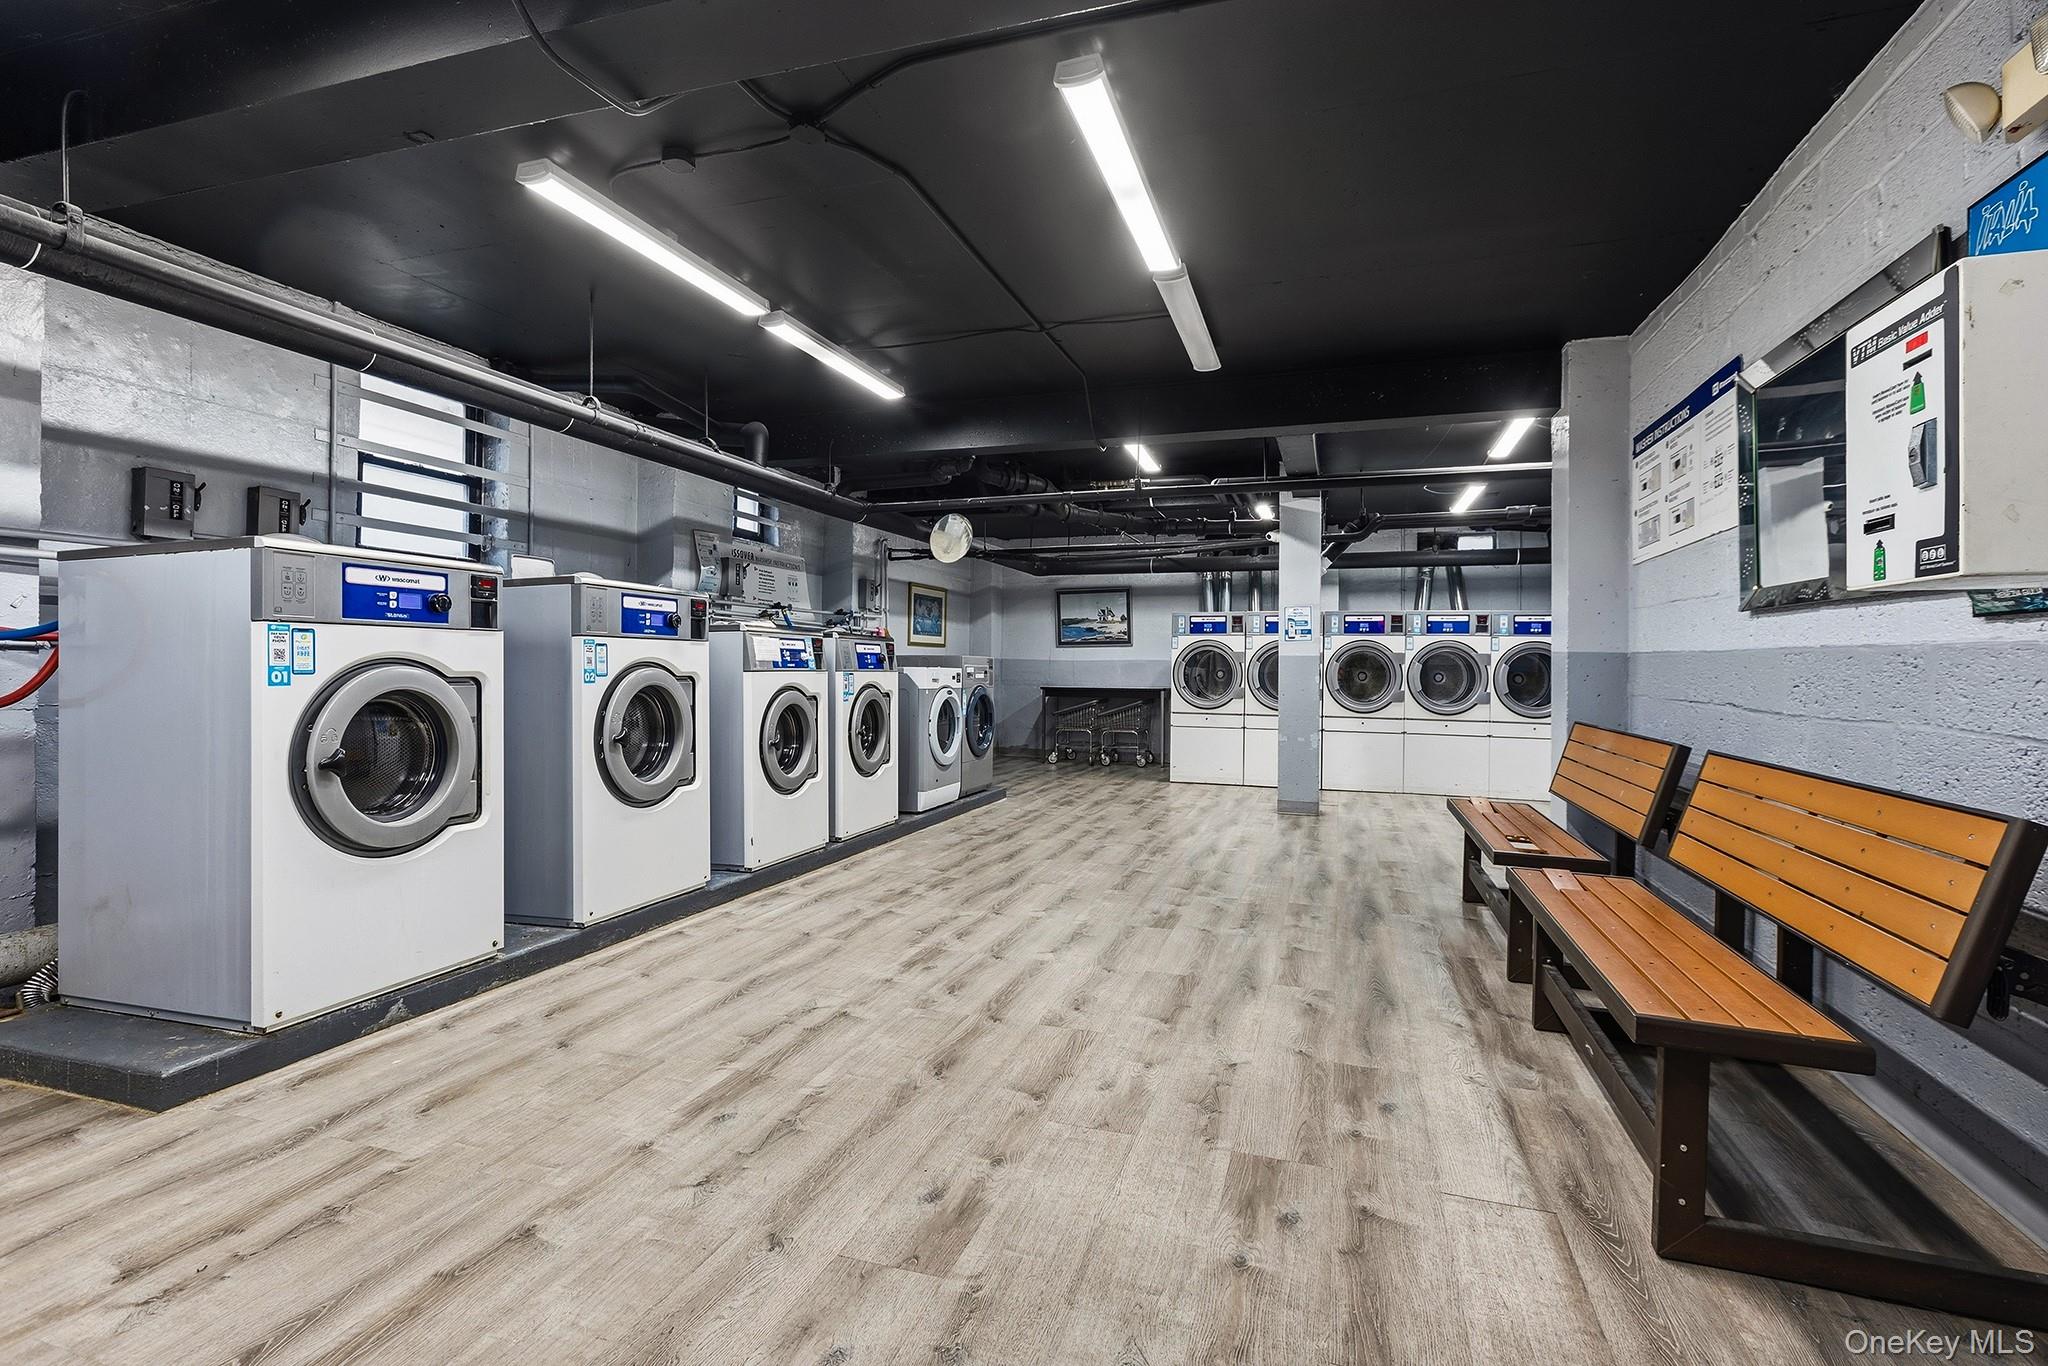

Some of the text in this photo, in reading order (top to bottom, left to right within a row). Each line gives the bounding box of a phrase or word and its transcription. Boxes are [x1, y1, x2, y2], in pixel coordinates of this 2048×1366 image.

[1878, 329, 1898, 347] Basic
[1898, 318, 1919, 337] Value
[1919, 303, 1944, 324] Adder
[1653, 405, 1690, 442] INSTRUCTIONS
[271, 670, 288, 684] 01
[584, 672, 595, 682] 02
